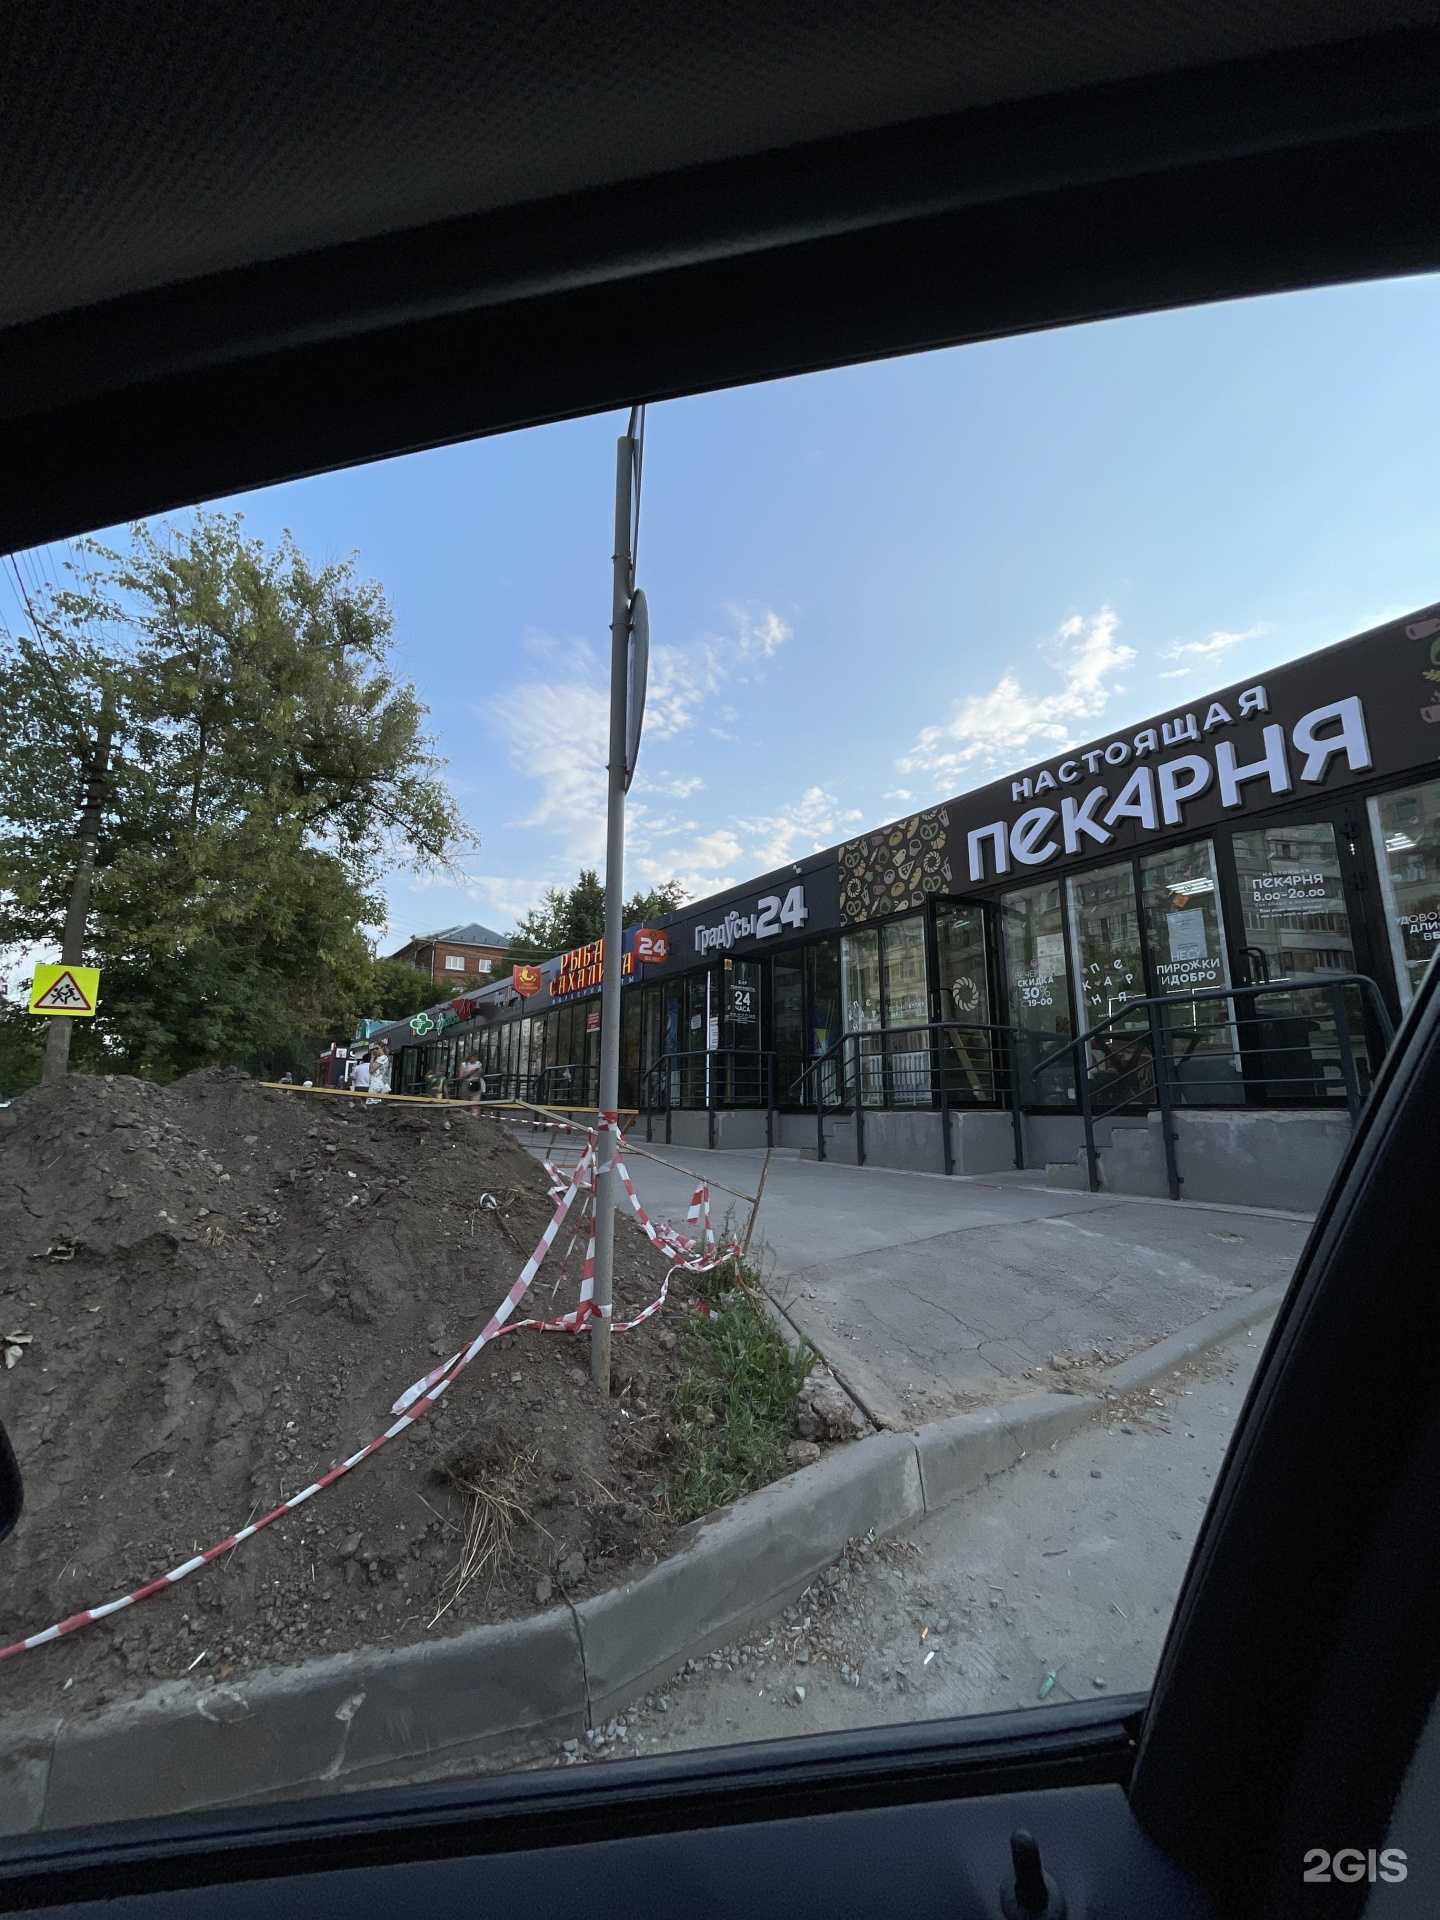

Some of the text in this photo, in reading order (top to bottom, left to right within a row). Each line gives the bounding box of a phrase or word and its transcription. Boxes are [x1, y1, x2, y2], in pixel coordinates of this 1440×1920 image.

[1012, 685, 1270, 801] НАСТОЯЩАЯ
[1392, 911, 1440, 926] УДОВО
[1410, 921, 1440, 934] ДЛИ
[639, 937, 667, 957] 24
[560, 938, 604, 976] РЫБА
[549, 952, 633, 997] САХАЛА
[1156, 958, 1220, 975] ПИРОЖКИ
[1017, 975, 1054, 987] СКИДКА
[735, 990, 750, 1005] 24
